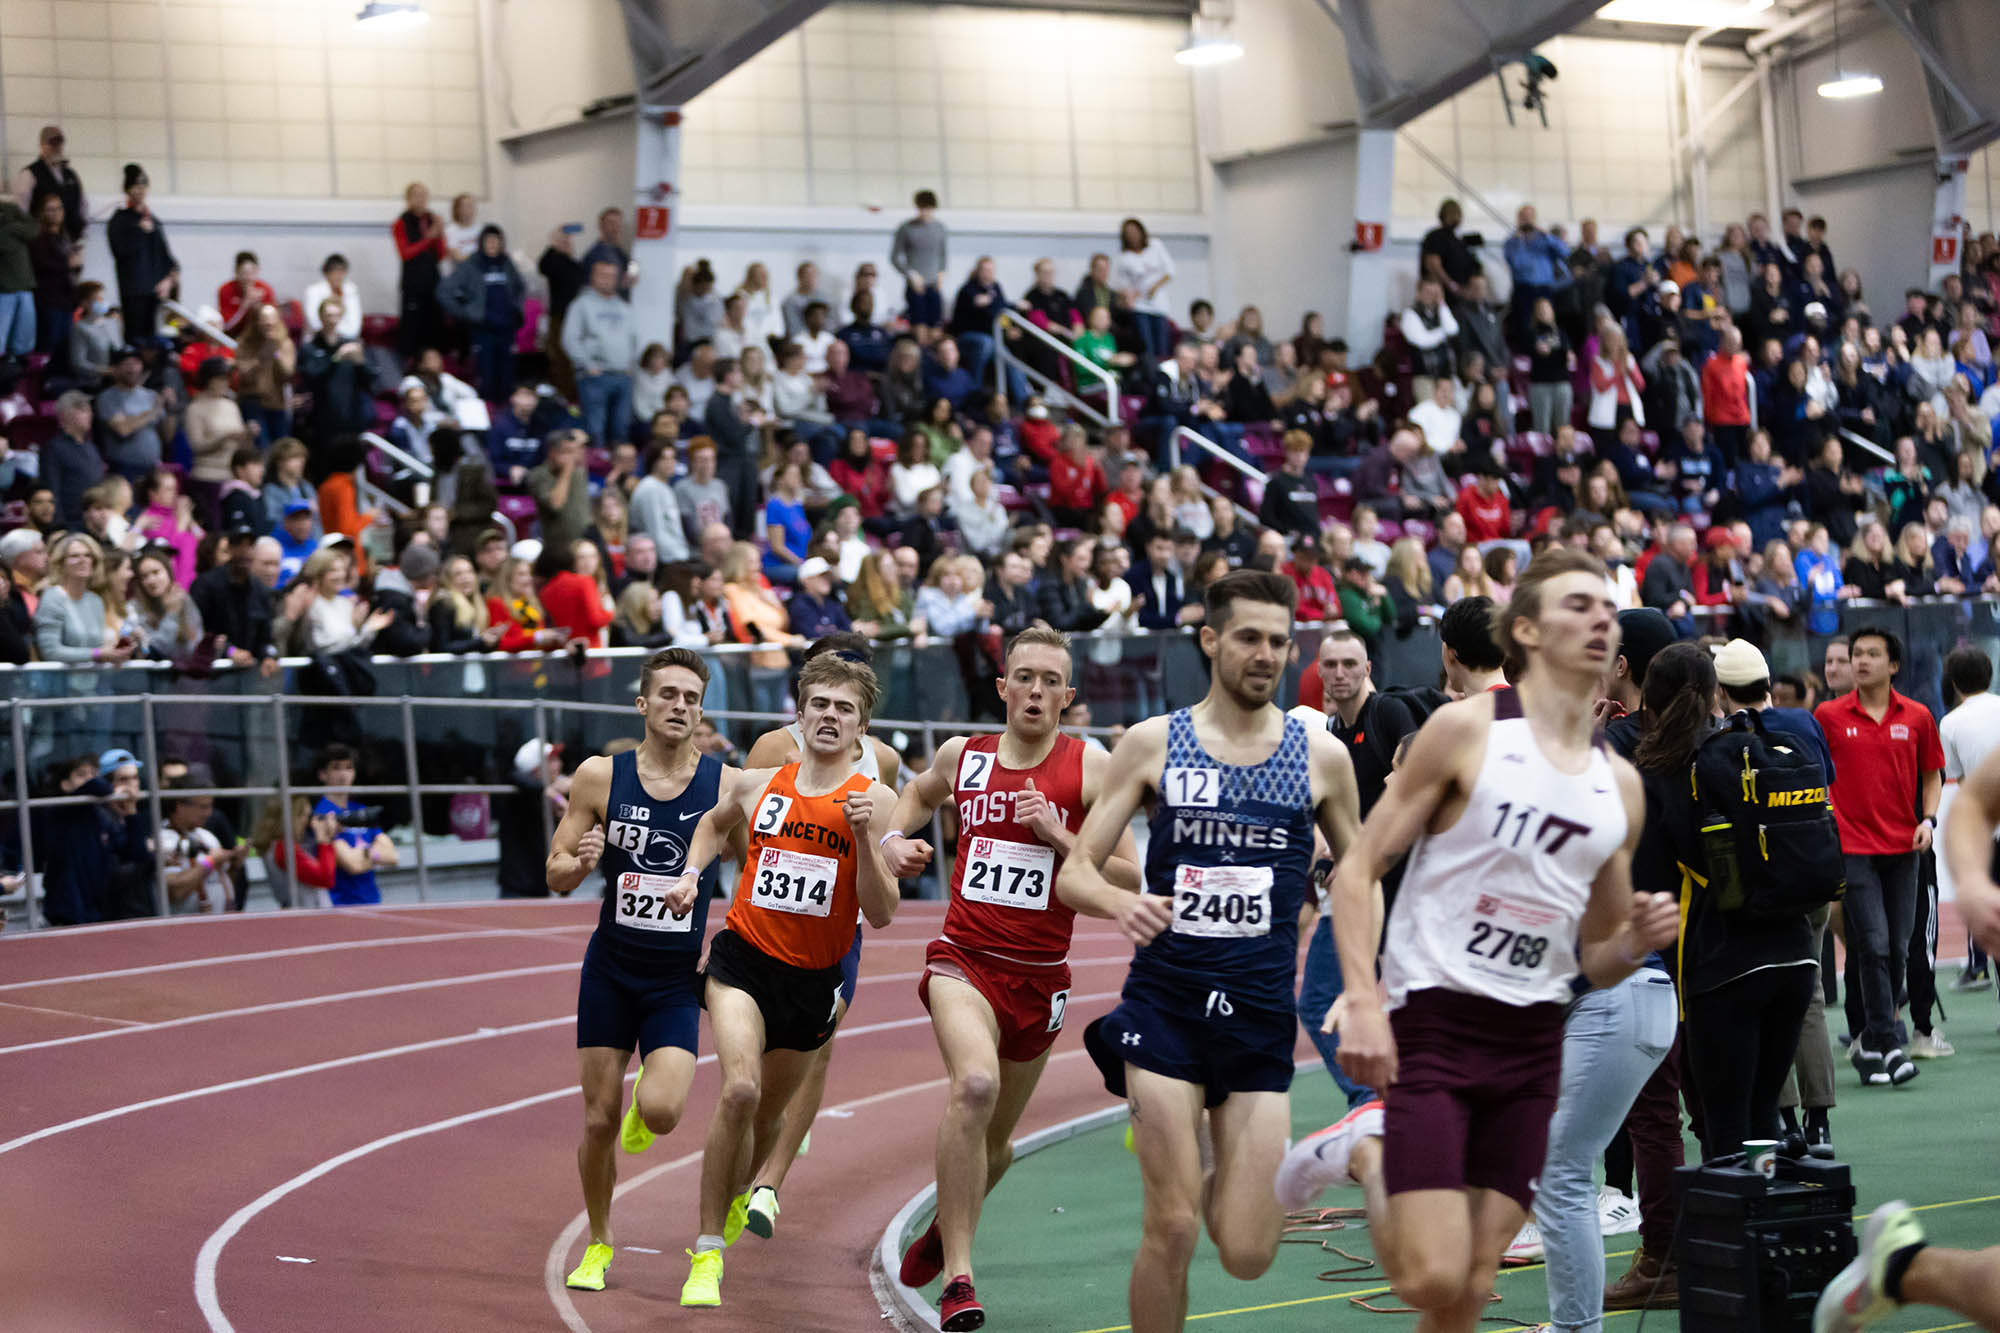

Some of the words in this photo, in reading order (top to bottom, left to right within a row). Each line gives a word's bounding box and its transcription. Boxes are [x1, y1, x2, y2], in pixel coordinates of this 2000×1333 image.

[963, 754, 987, 788] 2
[1176, 770, 1208, 803] 12
[758, 797, 784, 830] 3
[1176, 808, 1235, 822] COLORADO
[1492, 802, 1529, 847] 11
[616, 825, 642, 851] 13
[1173, 818, 1289, 849] MINES
[757, 870, 827, 906] 3314
[968, 861, 1045, 898] 2173
[1180, 892, 1262, 925] 2405
[1466, 921, 1549, 969] 2768
